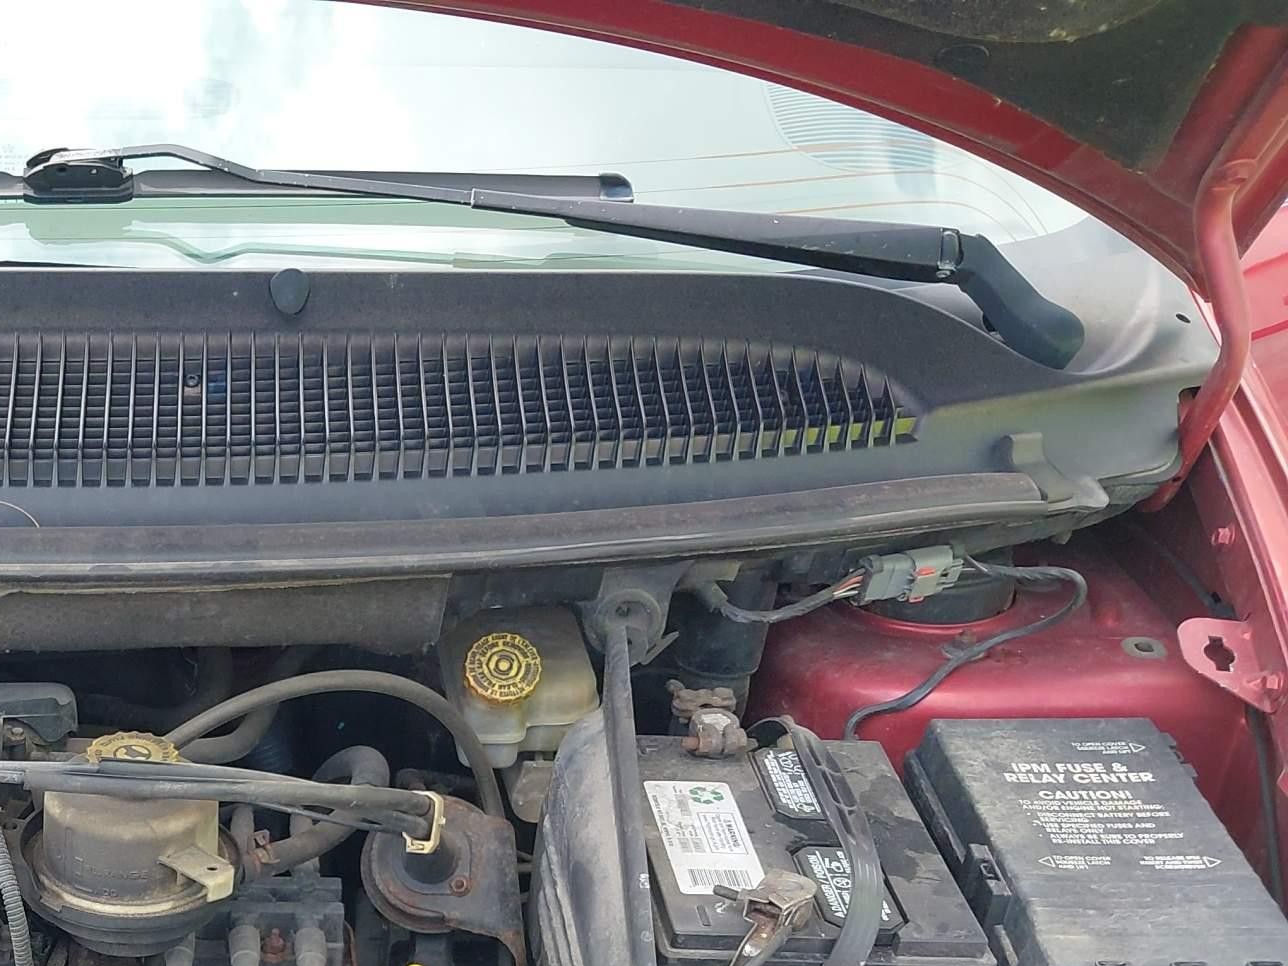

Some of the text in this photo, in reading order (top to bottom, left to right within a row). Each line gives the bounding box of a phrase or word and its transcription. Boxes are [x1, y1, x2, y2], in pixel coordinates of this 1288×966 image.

[1012, 763, 1128, 773] IPM FUSE &
[1003, 773, 1156, 783] RELAY CENTER
[1039, 790, 1133, 799] CAUTION!
[807, 854, 827, 879] POISON
[821, 884, 842, 911] DANGER
